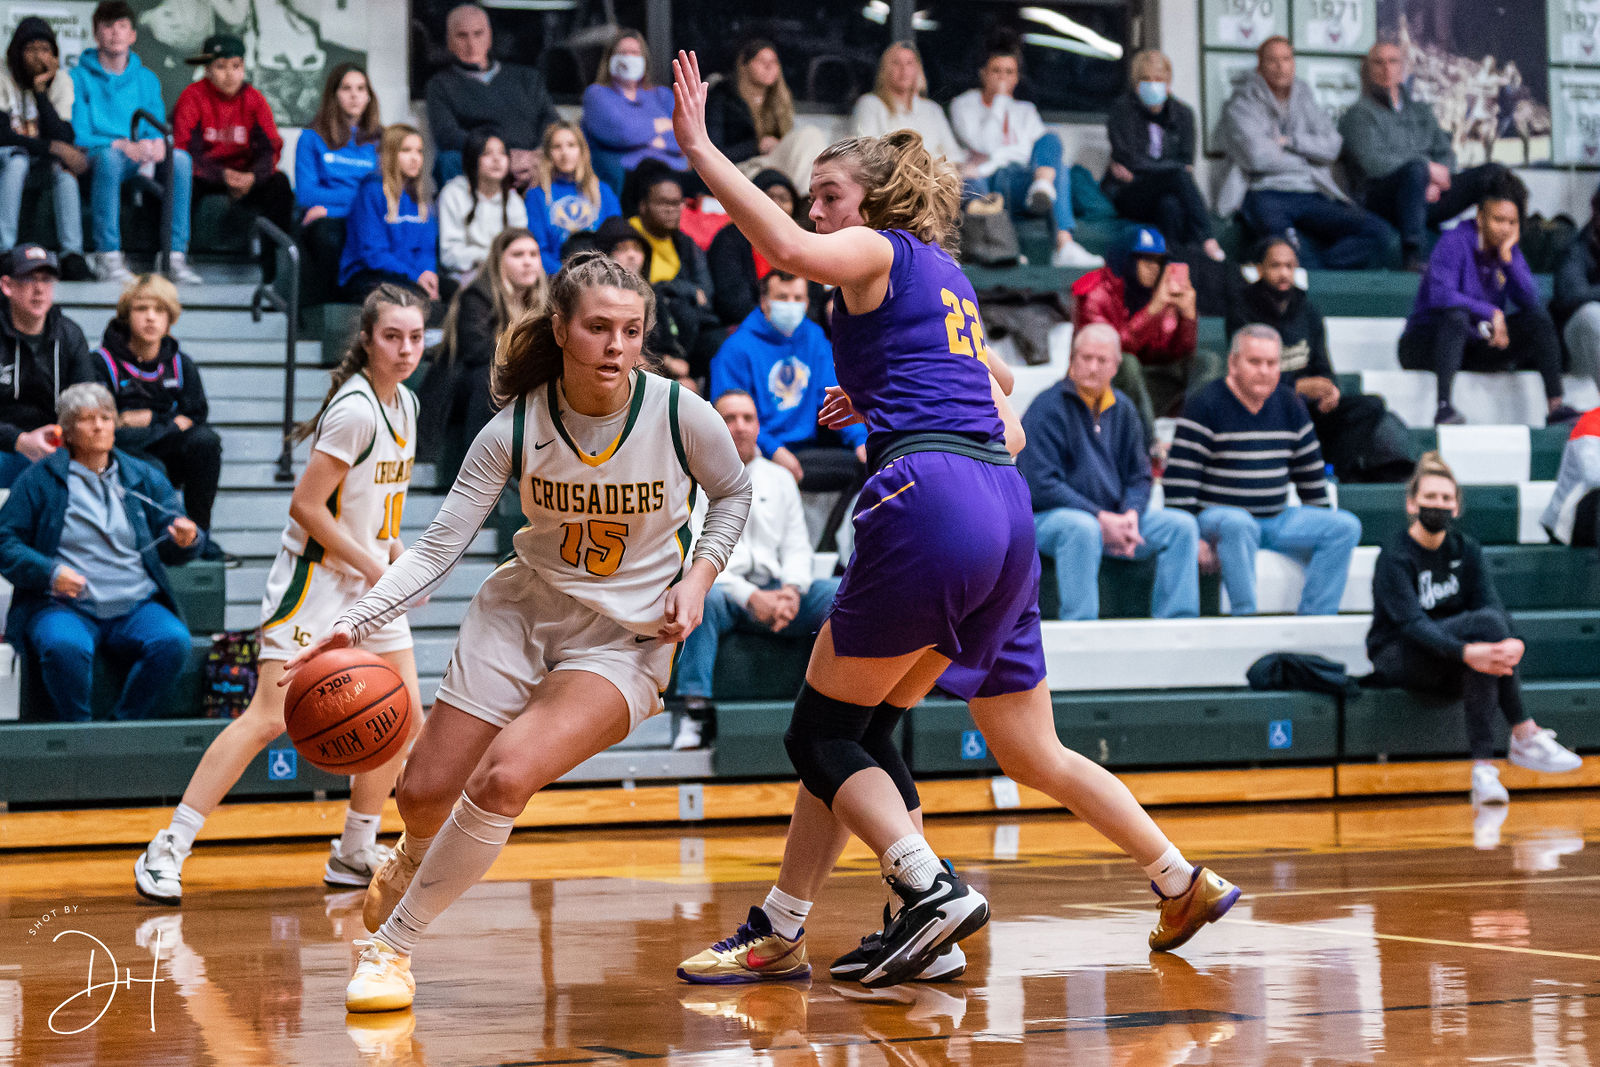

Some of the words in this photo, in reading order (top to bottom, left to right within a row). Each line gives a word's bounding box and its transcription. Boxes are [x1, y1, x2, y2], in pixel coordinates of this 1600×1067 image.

[940, 287, 990, 370] 22
[531, 476, 665, 515] CRUSADERS
[559, 519, 629, 577] 15
[293, 624, 312, 647] LC
[317, 673, 353, 698] ROCK
[317, 728, 365, 758] ROCK
[365, 705, 400, 743] THE
